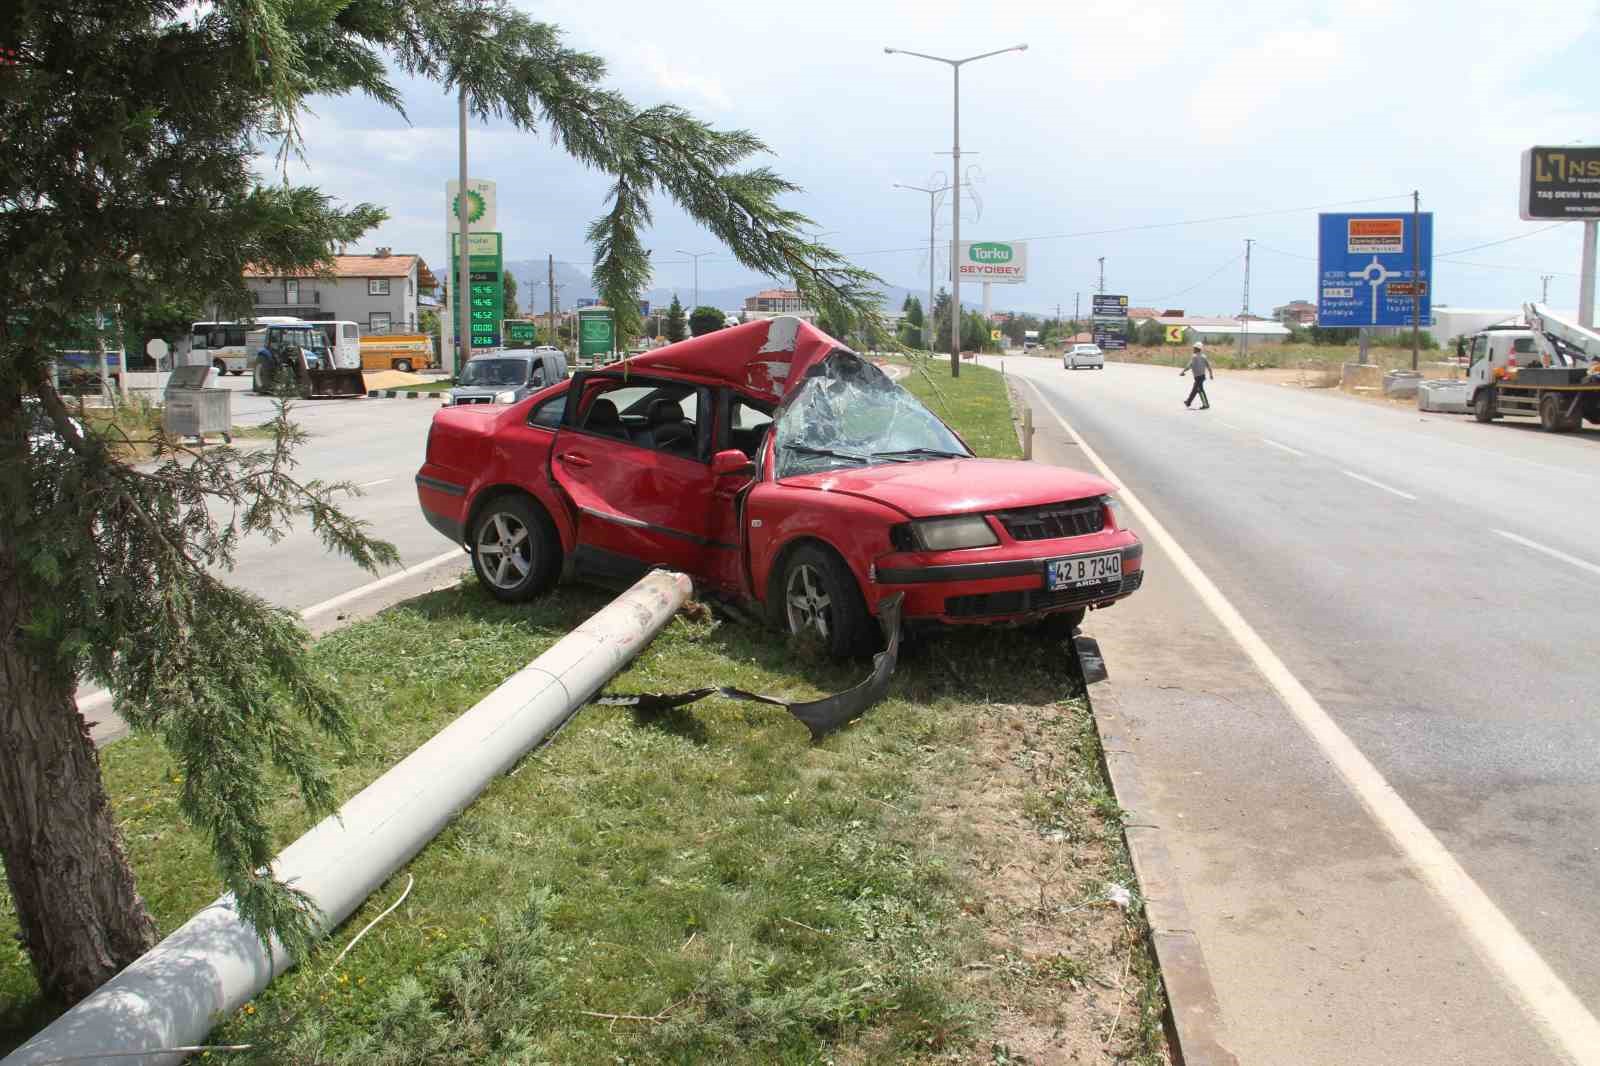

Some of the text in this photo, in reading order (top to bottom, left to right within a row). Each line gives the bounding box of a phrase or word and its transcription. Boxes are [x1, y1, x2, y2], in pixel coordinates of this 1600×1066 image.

[972, 247, 1009, 260] Torku
[1056, 556, 1120, 581] 42 B 7340
